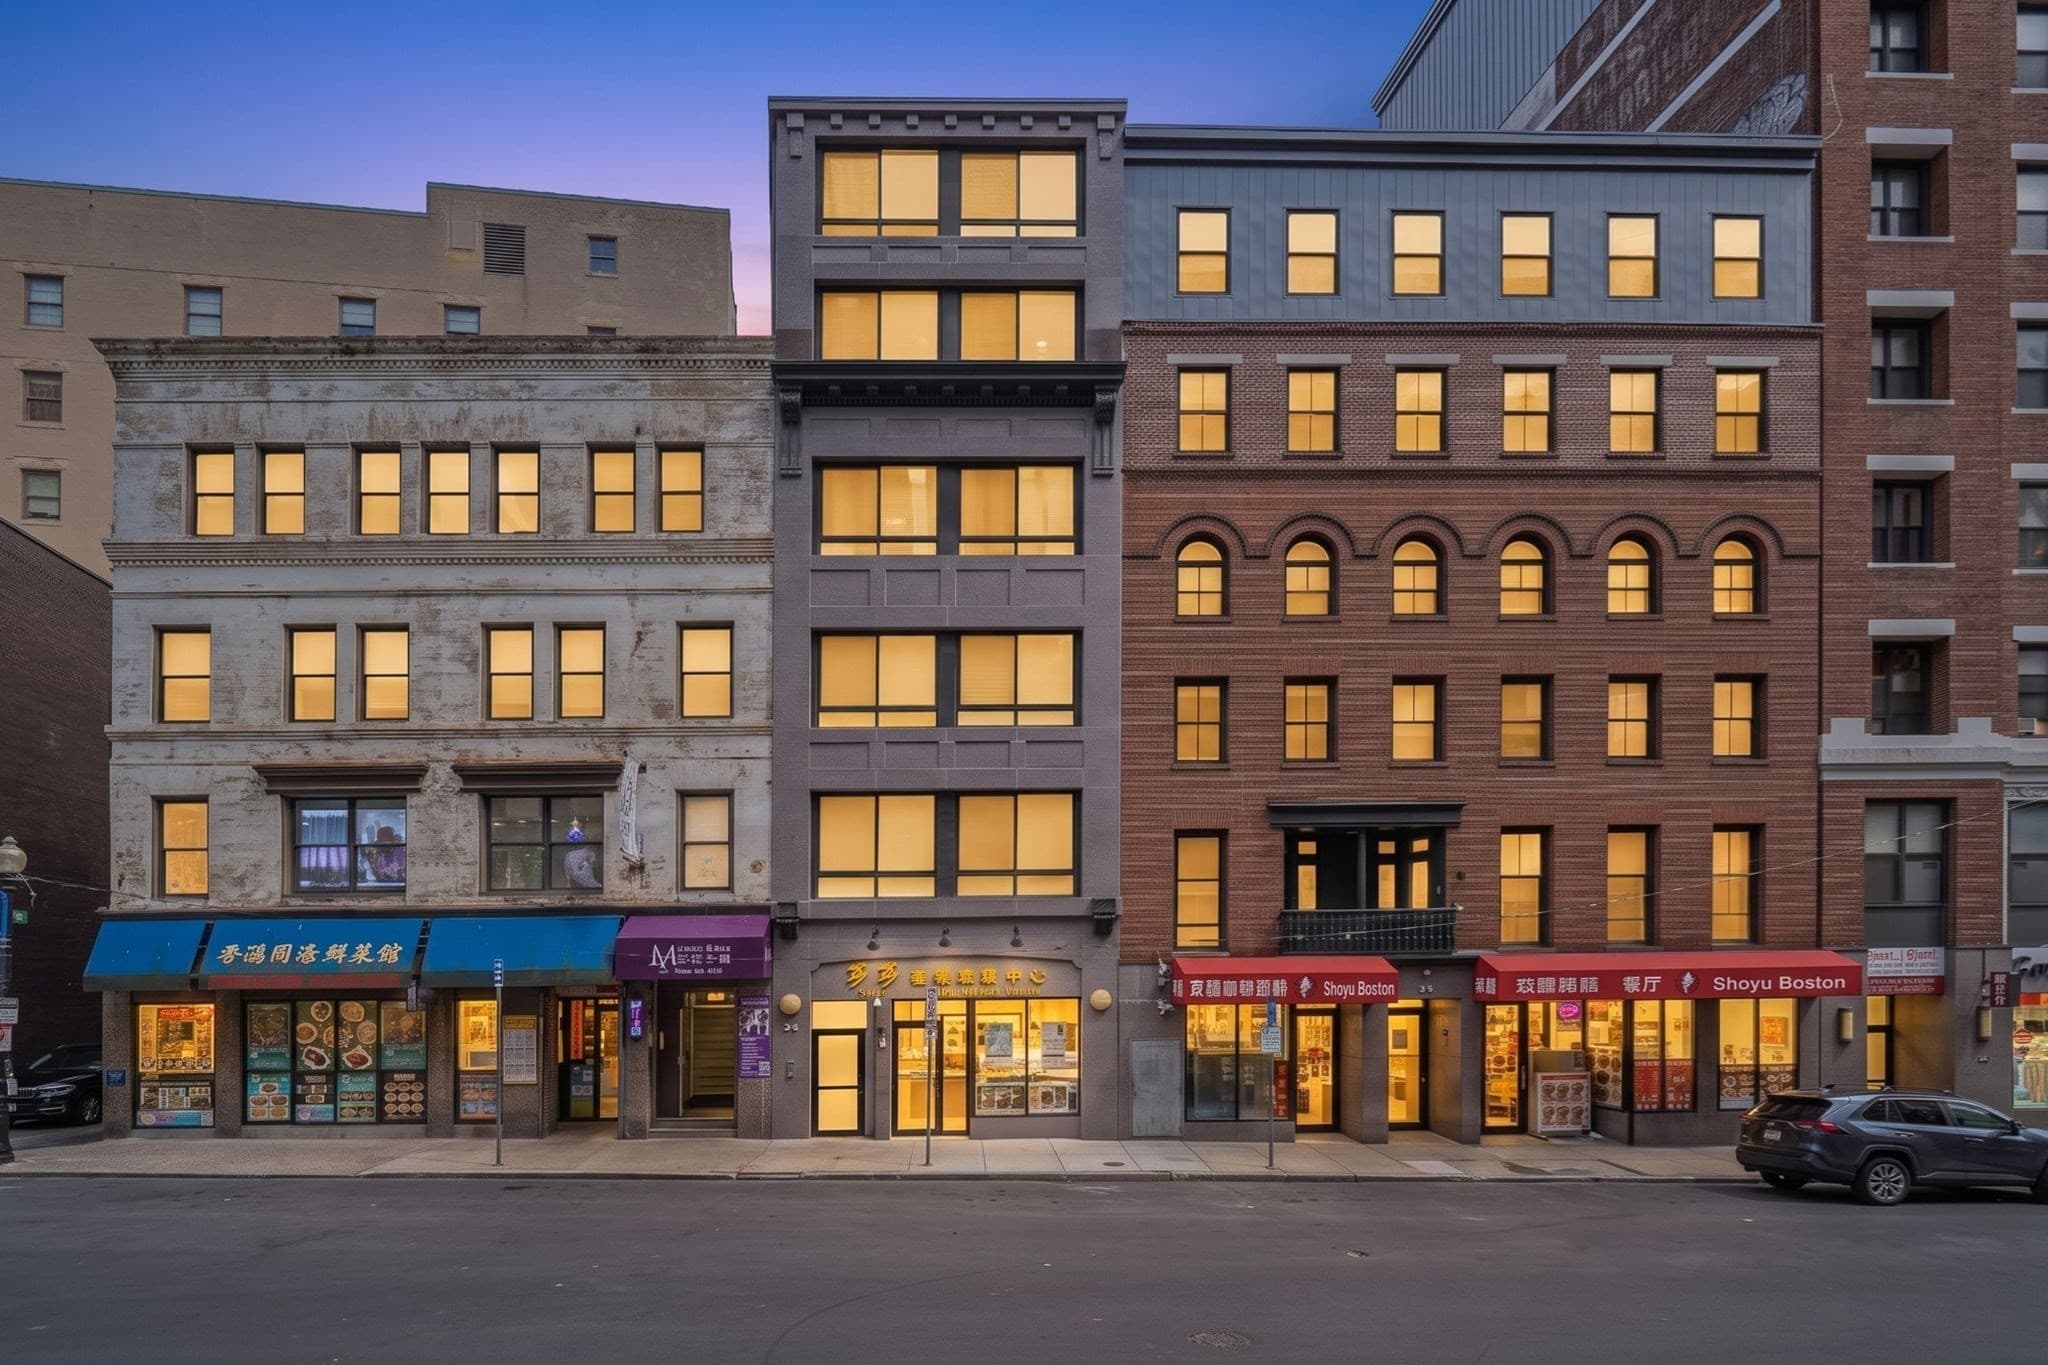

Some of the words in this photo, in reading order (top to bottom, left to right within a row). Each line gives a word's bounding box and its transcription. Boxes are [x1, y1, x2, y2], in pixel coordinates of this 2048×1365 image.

[1324, 981, 1354, 999] Shoyu
[1358, 981, 1394, 995] Boston
[1714, 977, 1772, 993] Shoyu
[1779, 976, 1846, 990] Boston
